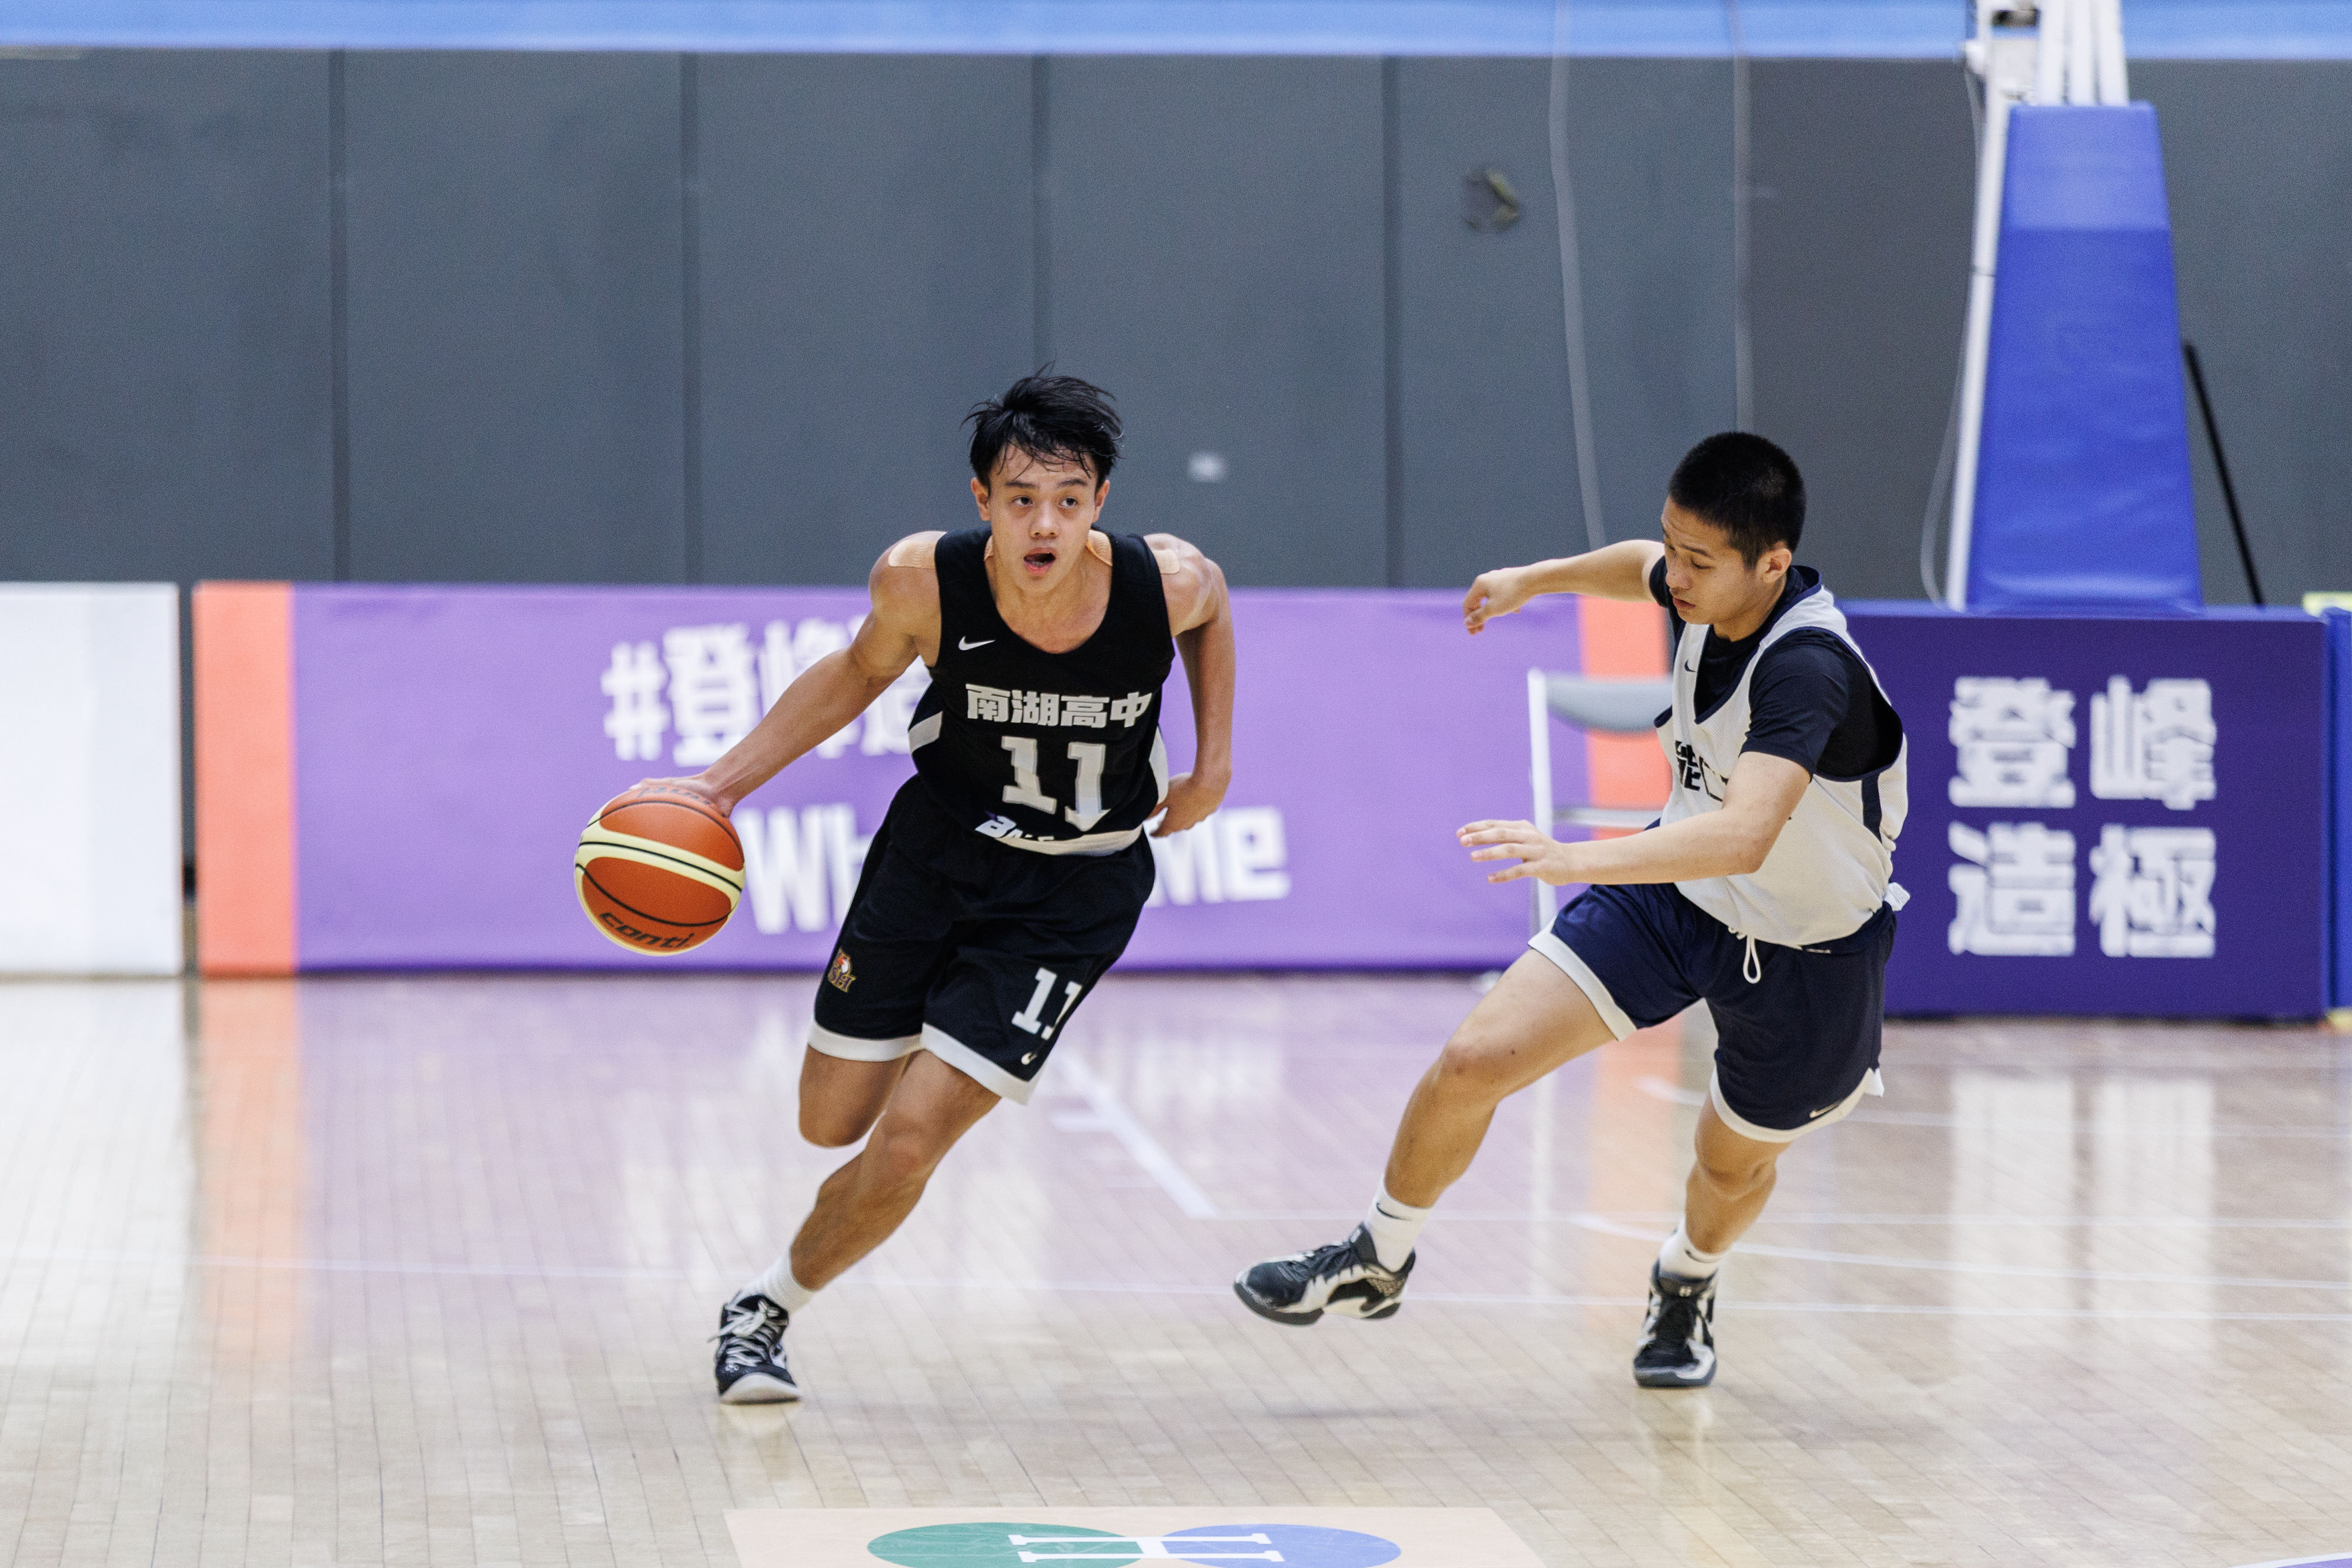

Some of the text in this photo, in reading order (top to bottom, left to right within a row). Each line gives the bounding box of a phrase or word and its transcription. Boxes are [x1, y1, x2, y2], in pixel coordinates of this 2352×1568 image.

[965, 684, 1152, 728] 南湖高中
[1949, 676, 2217, 810] 登峰
[1001, 735, 1112, 831] 11
[599, 912, 695, 948] conti
[1948, 821, 2216, 958] 造極
